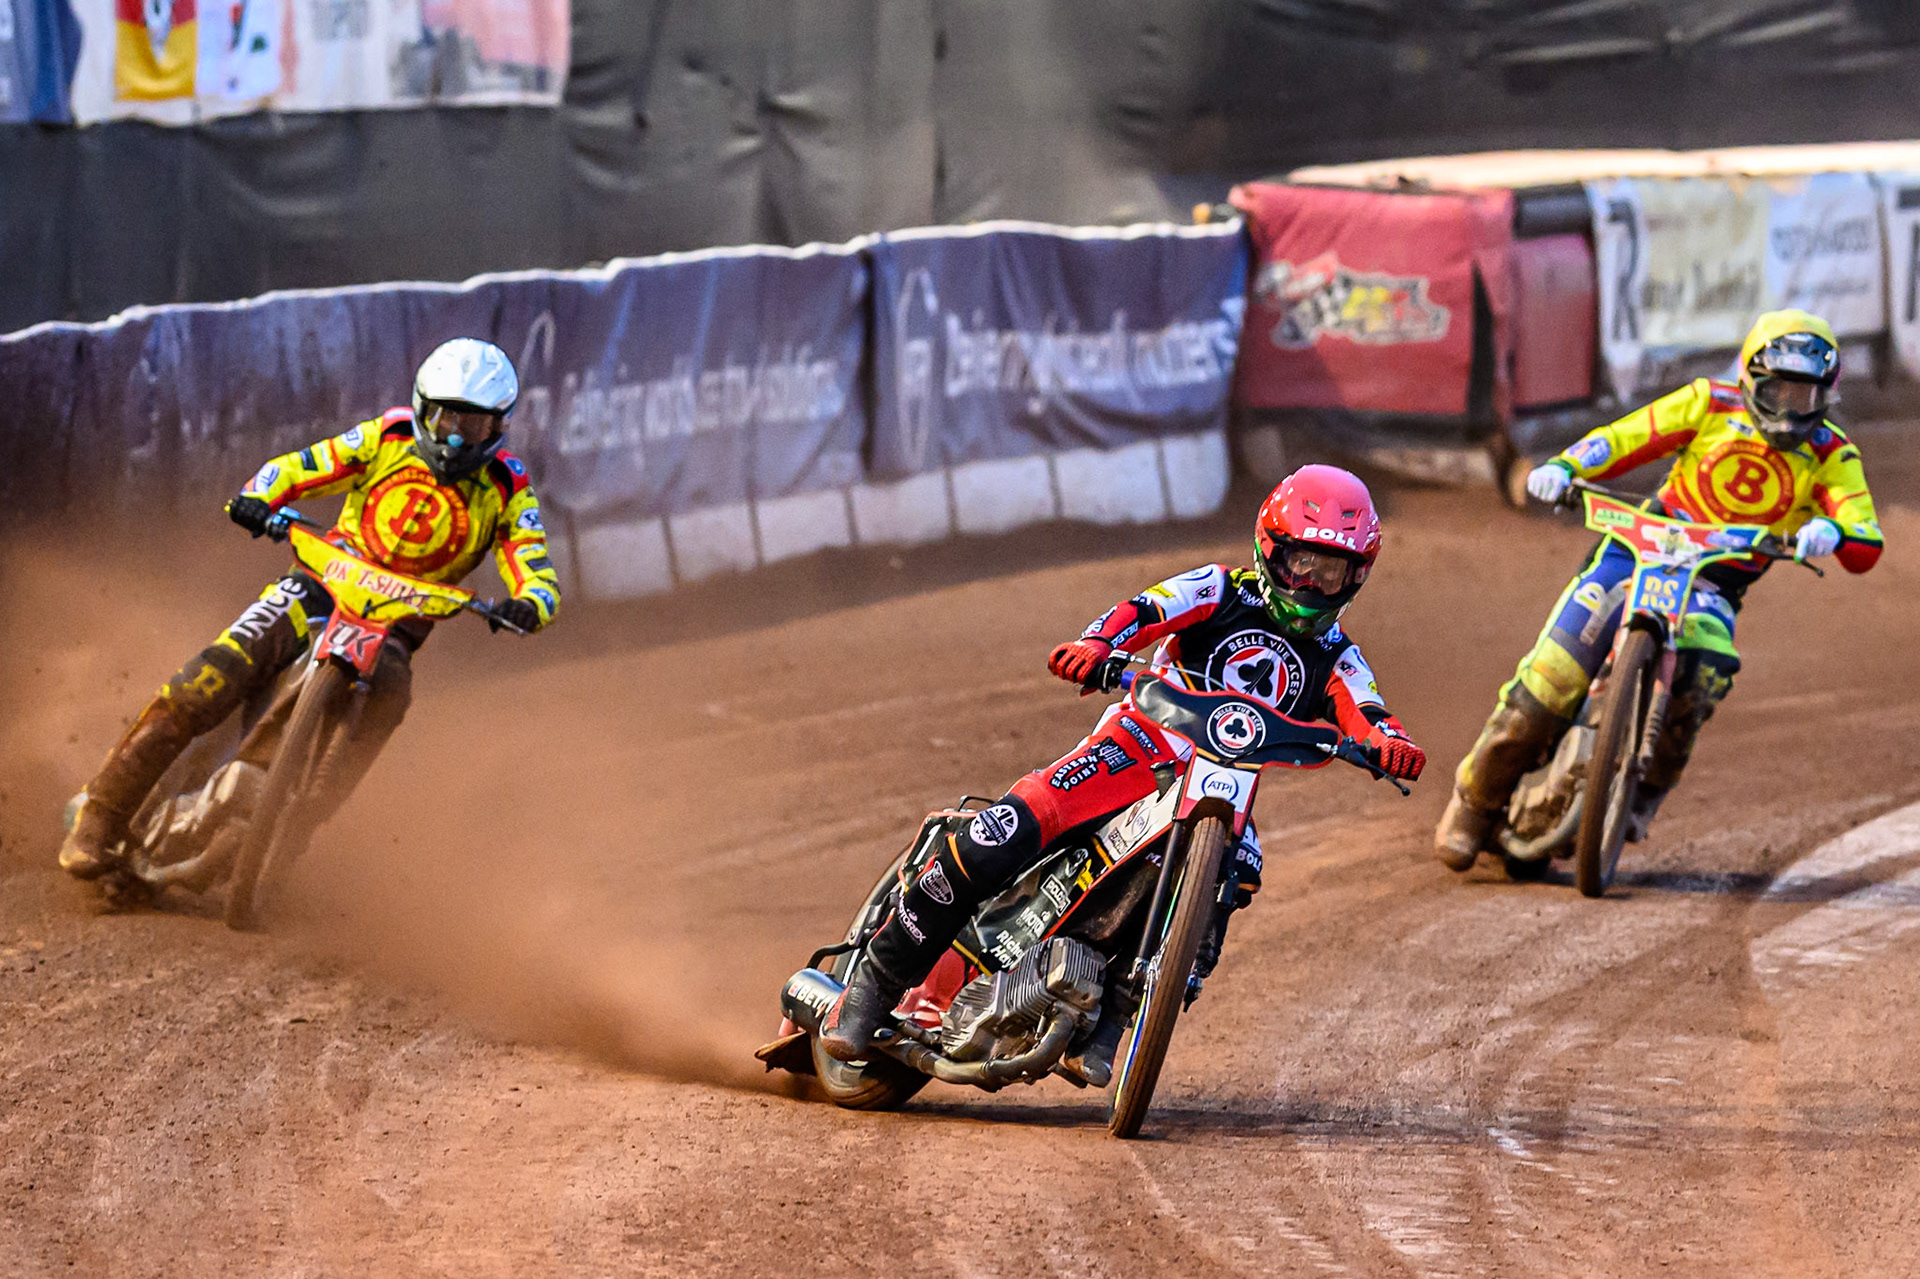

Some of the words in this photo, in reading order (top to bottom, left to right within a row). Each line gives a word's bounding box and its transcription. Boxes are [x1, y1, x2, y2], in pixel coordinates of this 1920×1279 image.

[1724, 456, 1769, 504] B
[388, 488, 441, 545] B
[1302, 527, 1356, 550] BOLL
[1227, 635, 1265, 652] BELLE
[1269, 640, 1291, 661] VUE
[1287, 663, 1300, 696] ACES
[1213, 705, 1234, 721] BELLE
[1235, 706, 1251, 717] VUE
[1250, 714, 1263, 732] ACES
[1051, 754, 1098, 788] EASTERN
[1062, 763, 1097, 791] POINT
[1207, 780, 1233, 794] ATPI
[913, 823, 942, 866] 1
[1235, 848, 1262, 872] BOLL
[990, 946, 1015, 969] Hay
